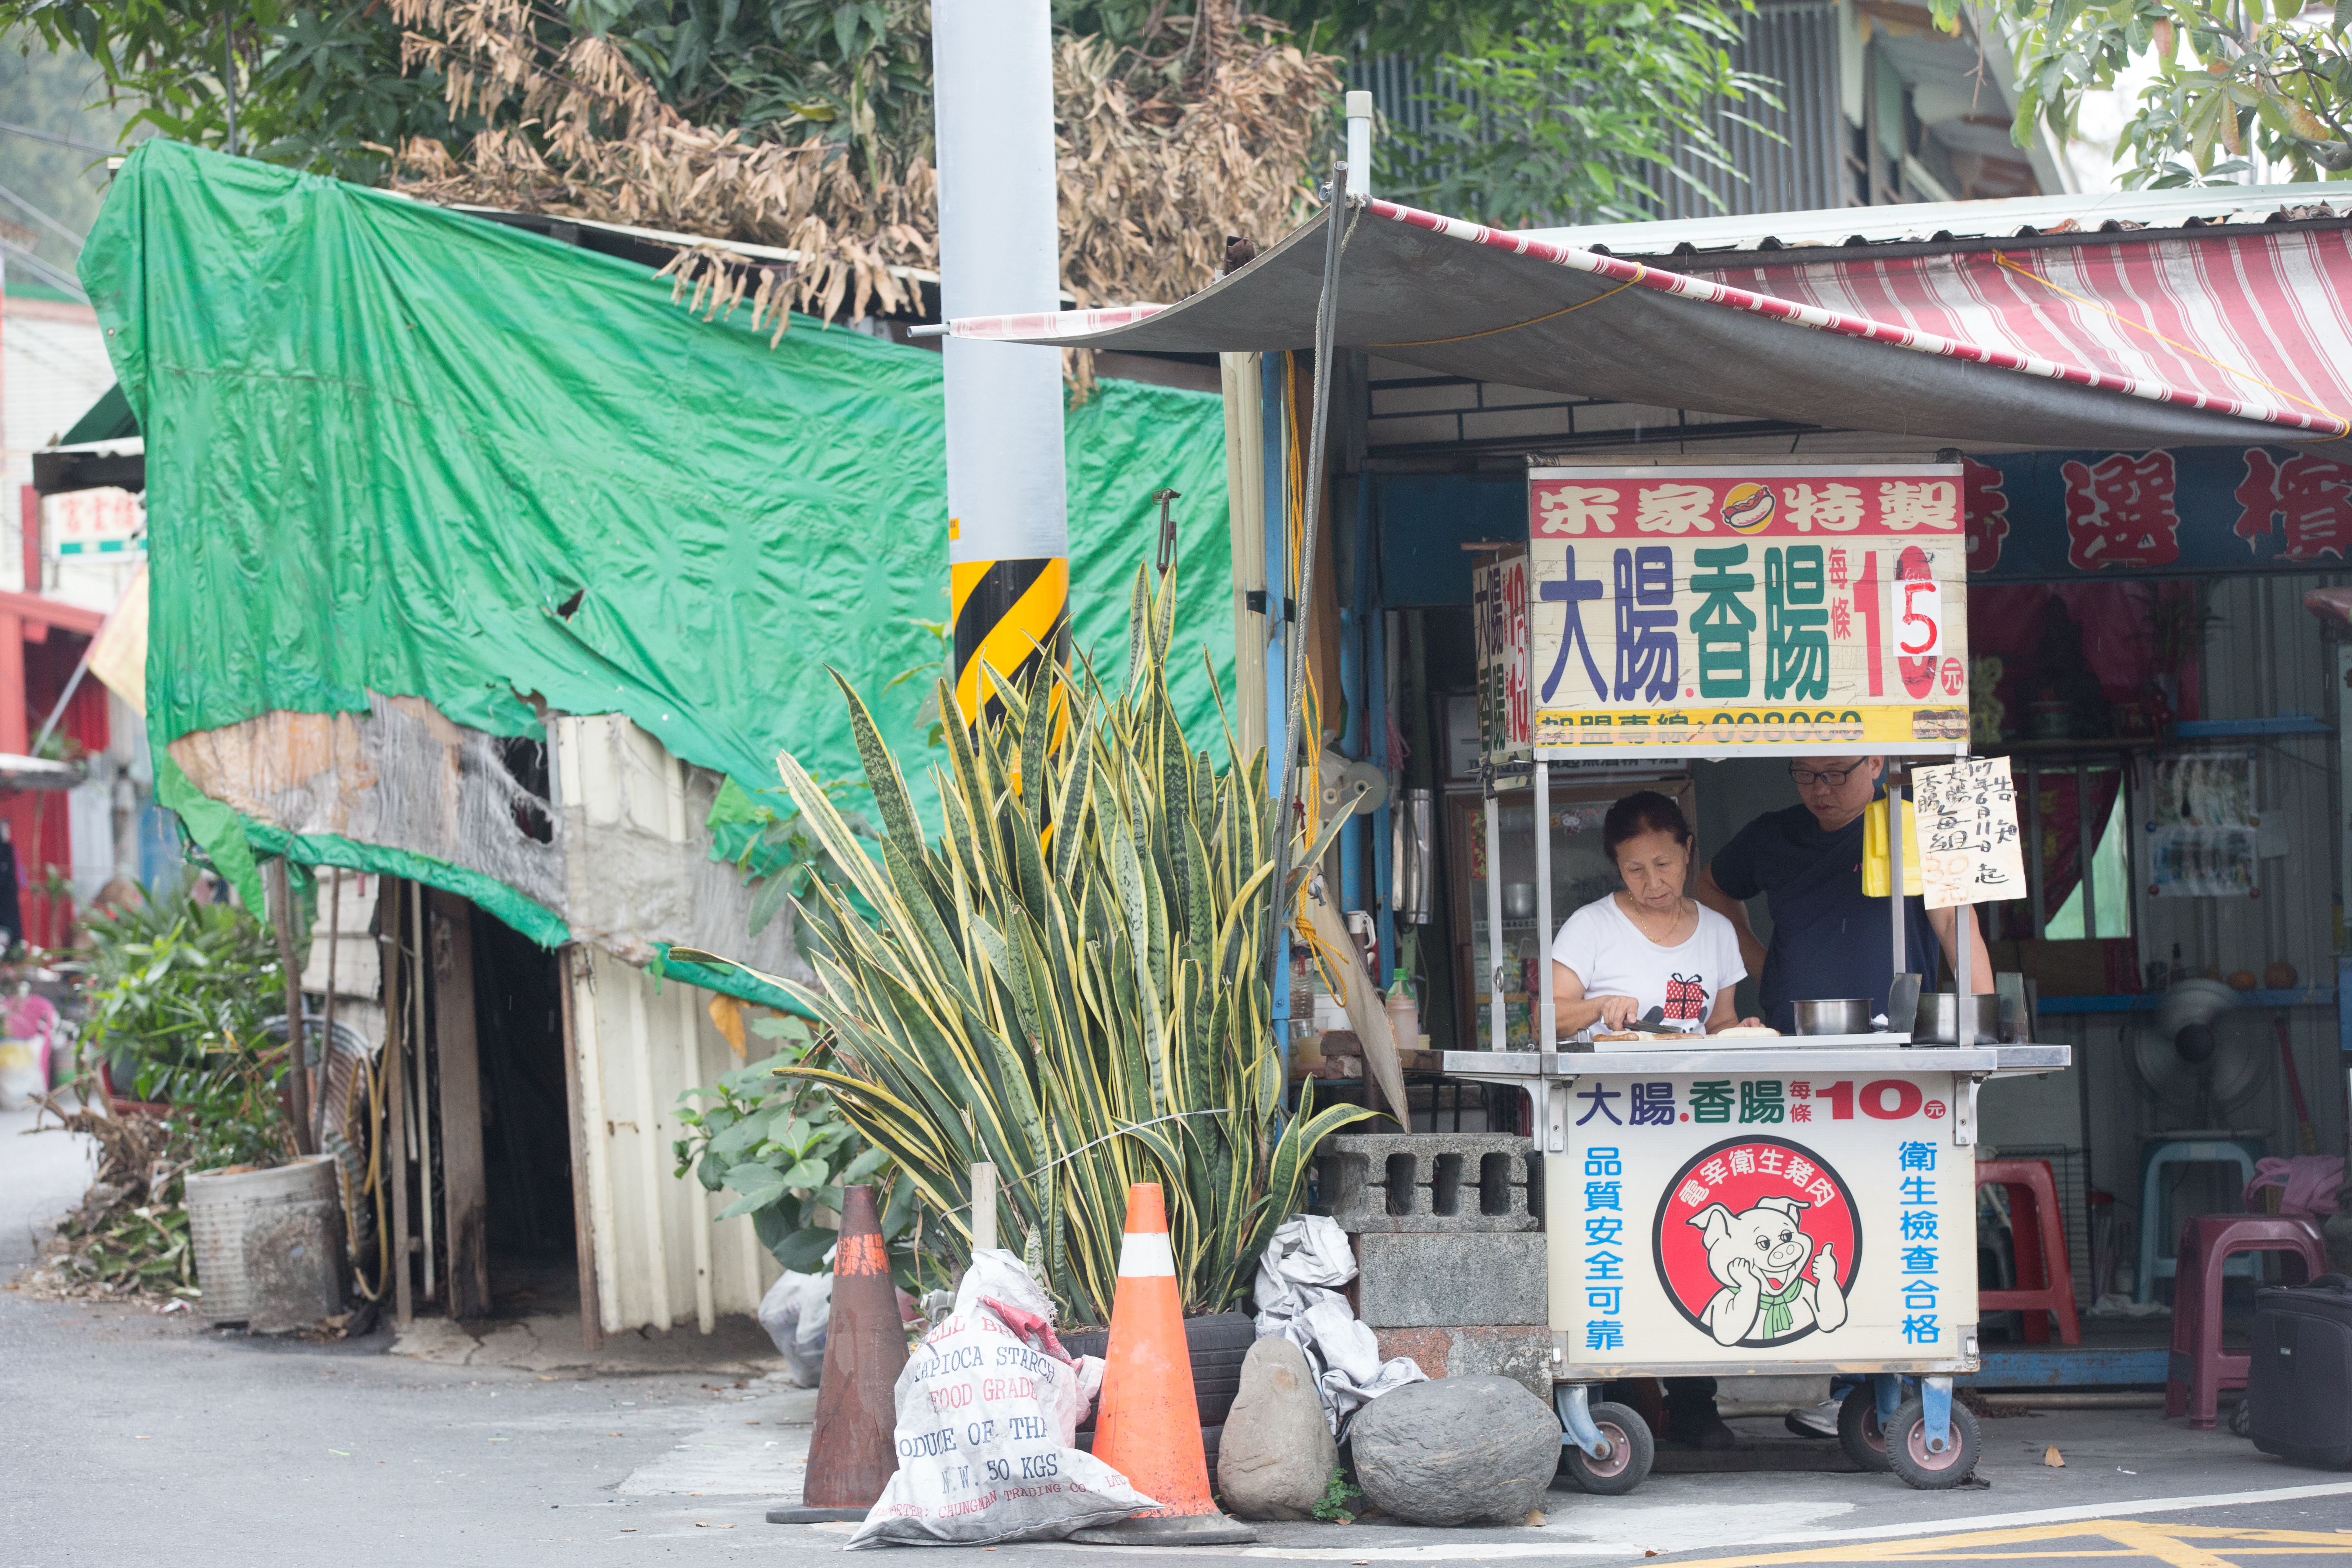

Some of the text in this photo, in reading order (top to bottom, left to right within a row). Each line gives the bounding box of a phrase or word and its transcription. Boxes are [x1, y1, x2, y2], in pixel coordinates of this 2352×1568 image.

[1782, 481, 1958, 532] 特製
[1828, 547, 1851, 640] 每條
[1943, 662, 1962, 690] 元
[1992, 775, 2017, 844] 告知
[1789, 1080, 1812, 1123] 每條
[1815, 1079, 1922, 1120] 10
[1927, 1101, 1944, 1117] 元
[1678, 1148, 1835, 1207] 電宰衛生豬肉
[1584, 1147, 1624, 1351] 品質安全可靠
[1898, 1140, 1940, 1345] 衛生檢查合格
[920, 1316, 1018, 1348] ELL BR
[996, 1346, 1055, 1384] STARCH
[929, 1383, 973, 1413] FOOD
[896, 1427, 957, 1459] ODUCE
[968, 1420, 993, 1446] OF
[942, 1453, 1058, 1494] N.W. 50 KGS
[1004, 1484, 1062, 1502] TRADING
[1069, 1483, 1100, 1493] CO.,
